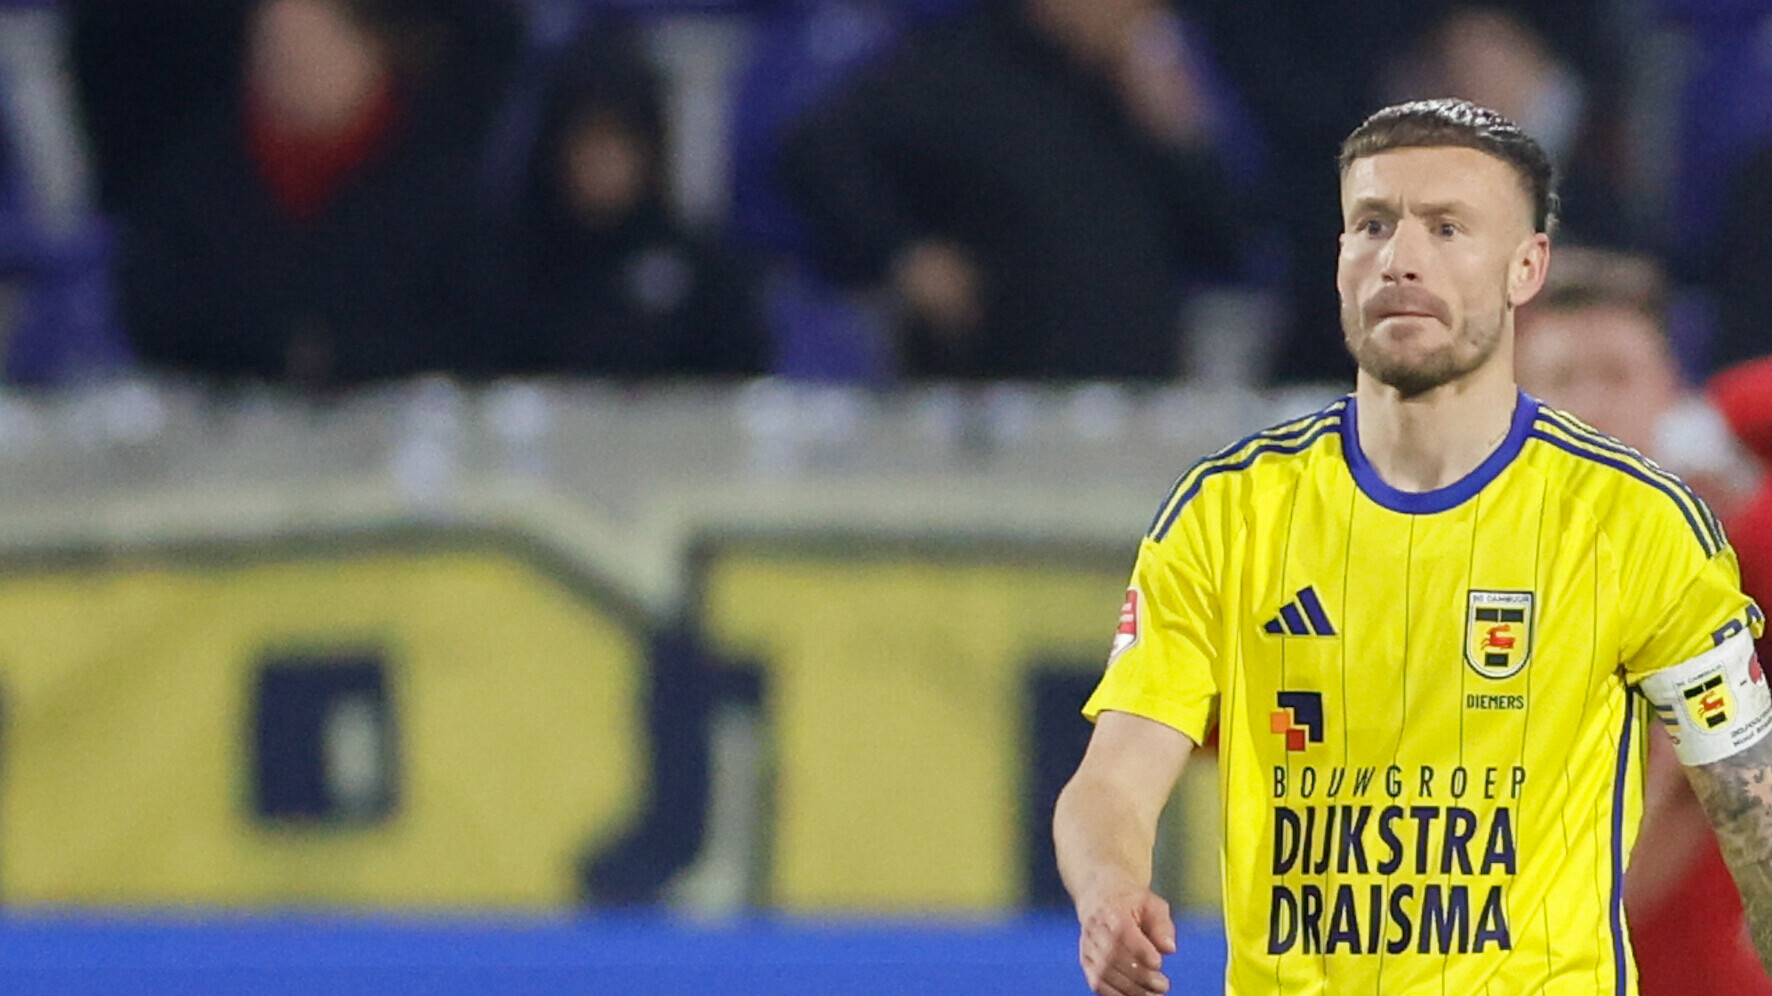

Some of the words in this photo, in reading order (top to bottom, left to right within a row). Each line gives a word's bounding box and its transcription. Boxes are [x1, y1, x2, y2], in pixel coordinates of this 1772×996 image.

[1466, 694, 1525, 710] DIEMERS
[1273, 764, 1527, 799] BOUWGROEP
[1272, 804, 1518, 876] DIJKSTRA
[1267, 883, 1513, 956] DRAISMA
